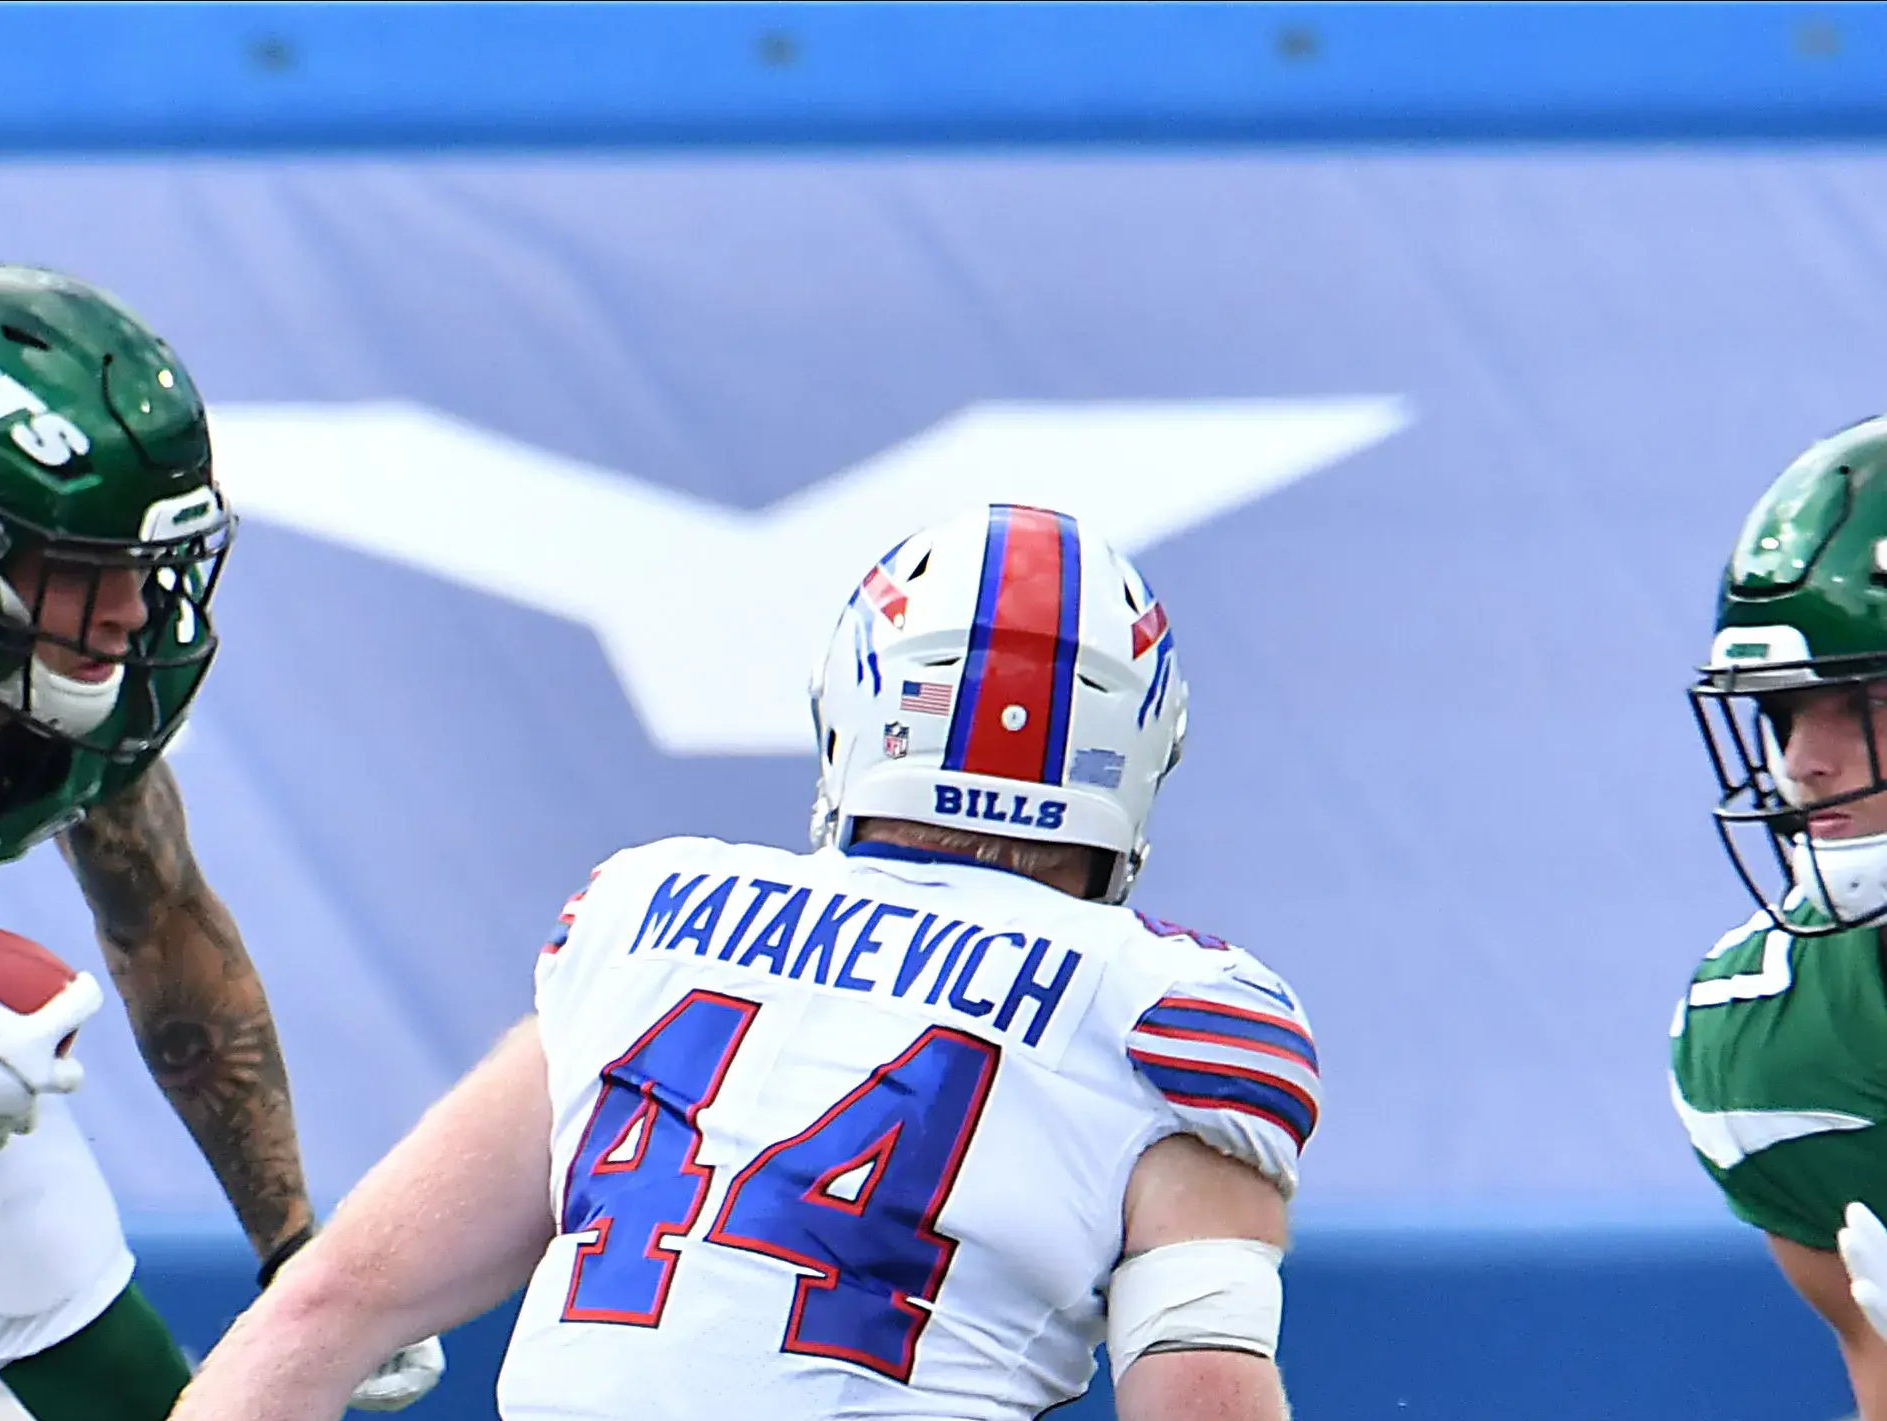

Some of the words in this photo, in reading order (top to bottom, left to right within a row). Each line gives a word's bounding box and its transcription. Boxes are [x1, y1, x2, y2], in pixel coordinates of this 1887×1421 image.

[934, 783, 1068, 831] BILLS
[629, 871, 1084, 1049] MATAKEVICH
[559, 987, 1003, 1386] 44
